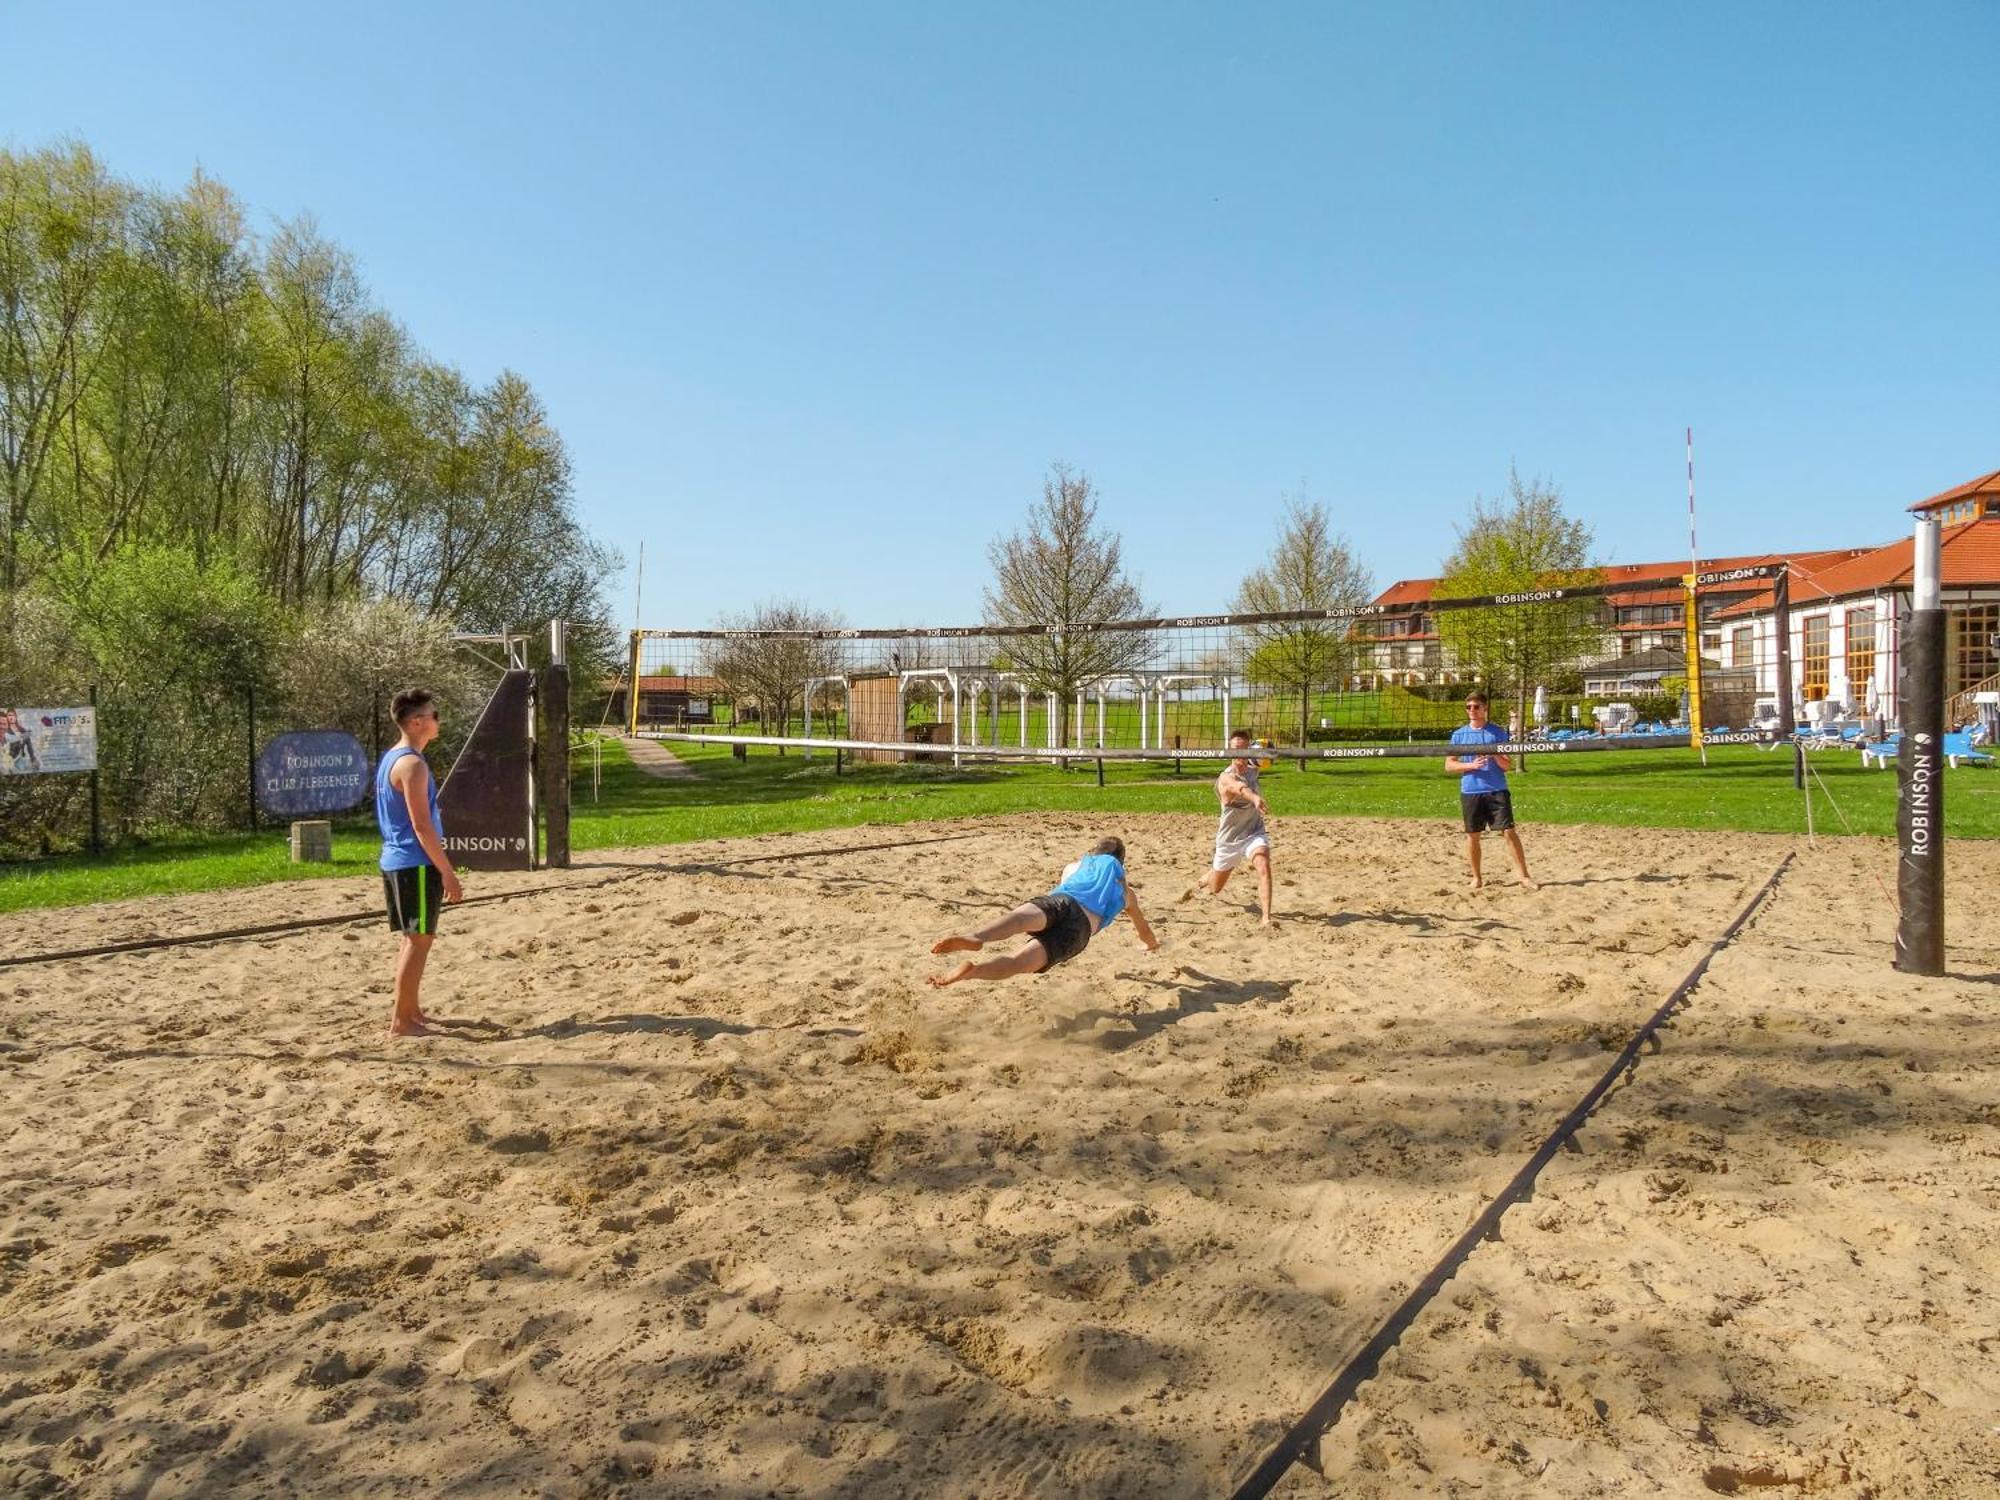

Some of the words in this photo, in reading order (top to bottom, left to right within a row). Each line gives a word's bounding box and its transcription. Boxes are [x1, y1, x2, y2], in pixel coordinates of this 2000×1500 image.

[1697, 569, 1754, 583] OBINSON
[1702, 733, 1759, 744] OBINSON
[268, 778, 296, 792] CLUB
[441, 837, 506, 851] BINSON
